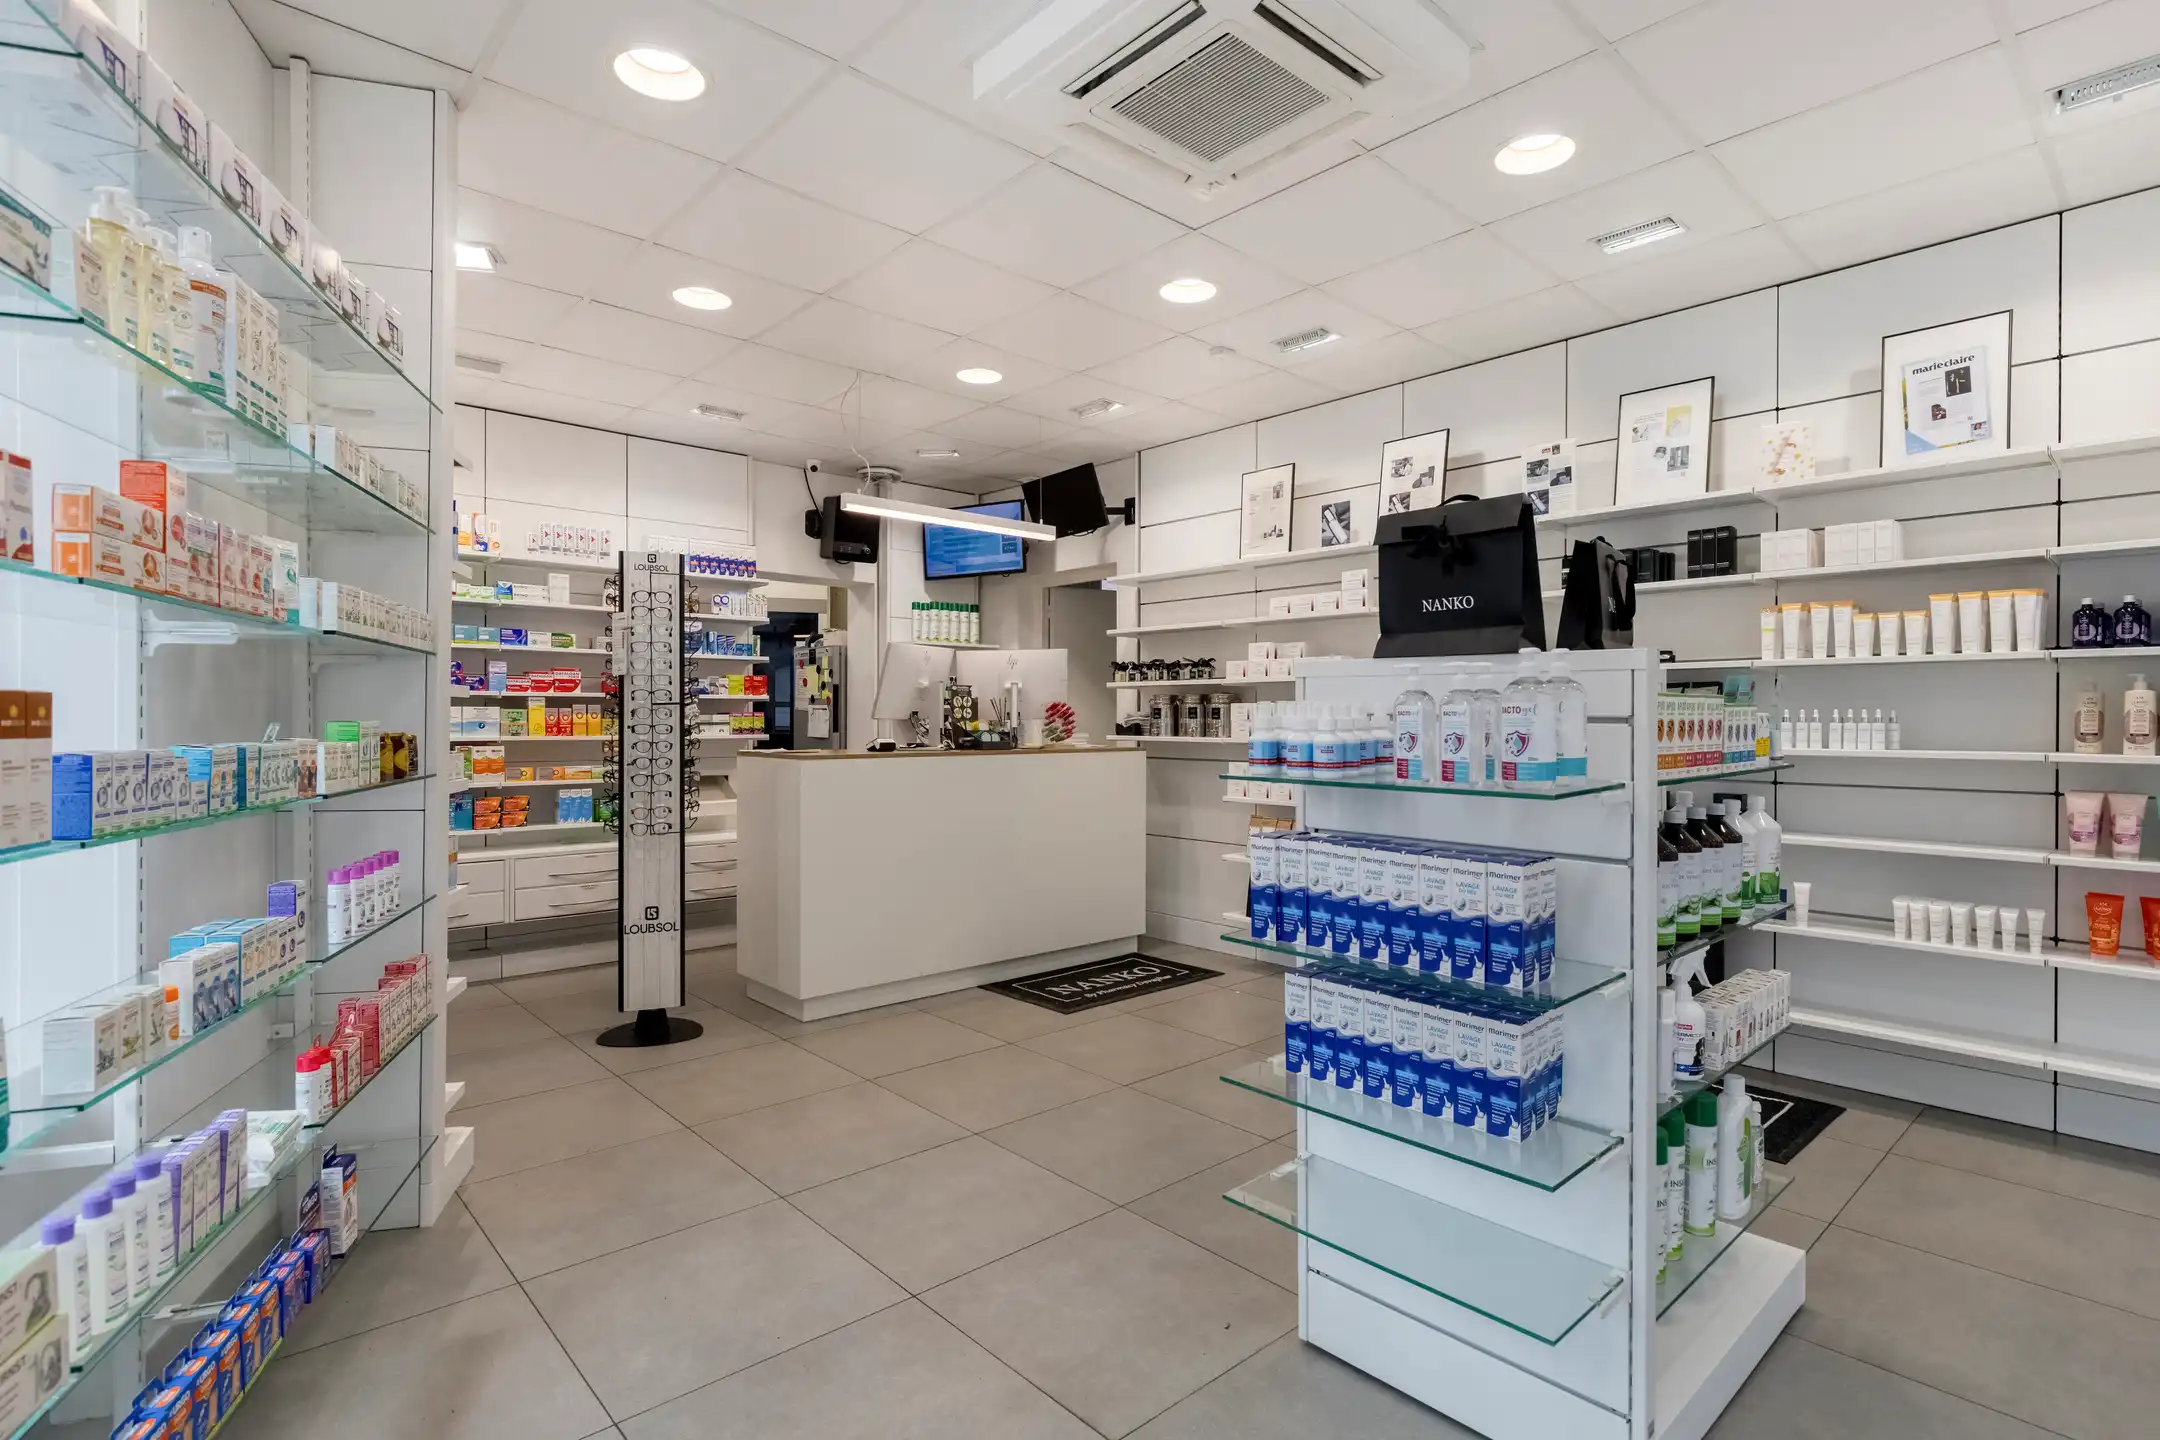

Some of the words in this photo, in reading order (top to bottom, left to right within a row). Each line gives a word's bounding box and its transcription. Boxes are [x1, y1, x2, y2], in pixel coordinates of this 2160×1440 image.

[634, 563, 669, 572] LOUBSOL
[1422, 595, 1474, 612] NANKO
[1363, 868, 1384, 877] LAVAGE
[1423, 877, 1446, 885] LAVAGE
[1455, 881, 1479, 890] LAVAGE
[1492, 885, 1518, 894] LAVAGE
[624, 922, 679, 934] LOUBSOL
[1045, 966, 1161, 995] NANKO
[1426, 1025, 1448, 1035] LAVAGE
[1458, 1034, 1481, 1043] LAVAGE
[1491, 1040, 1516, 1051] LAVAGE
